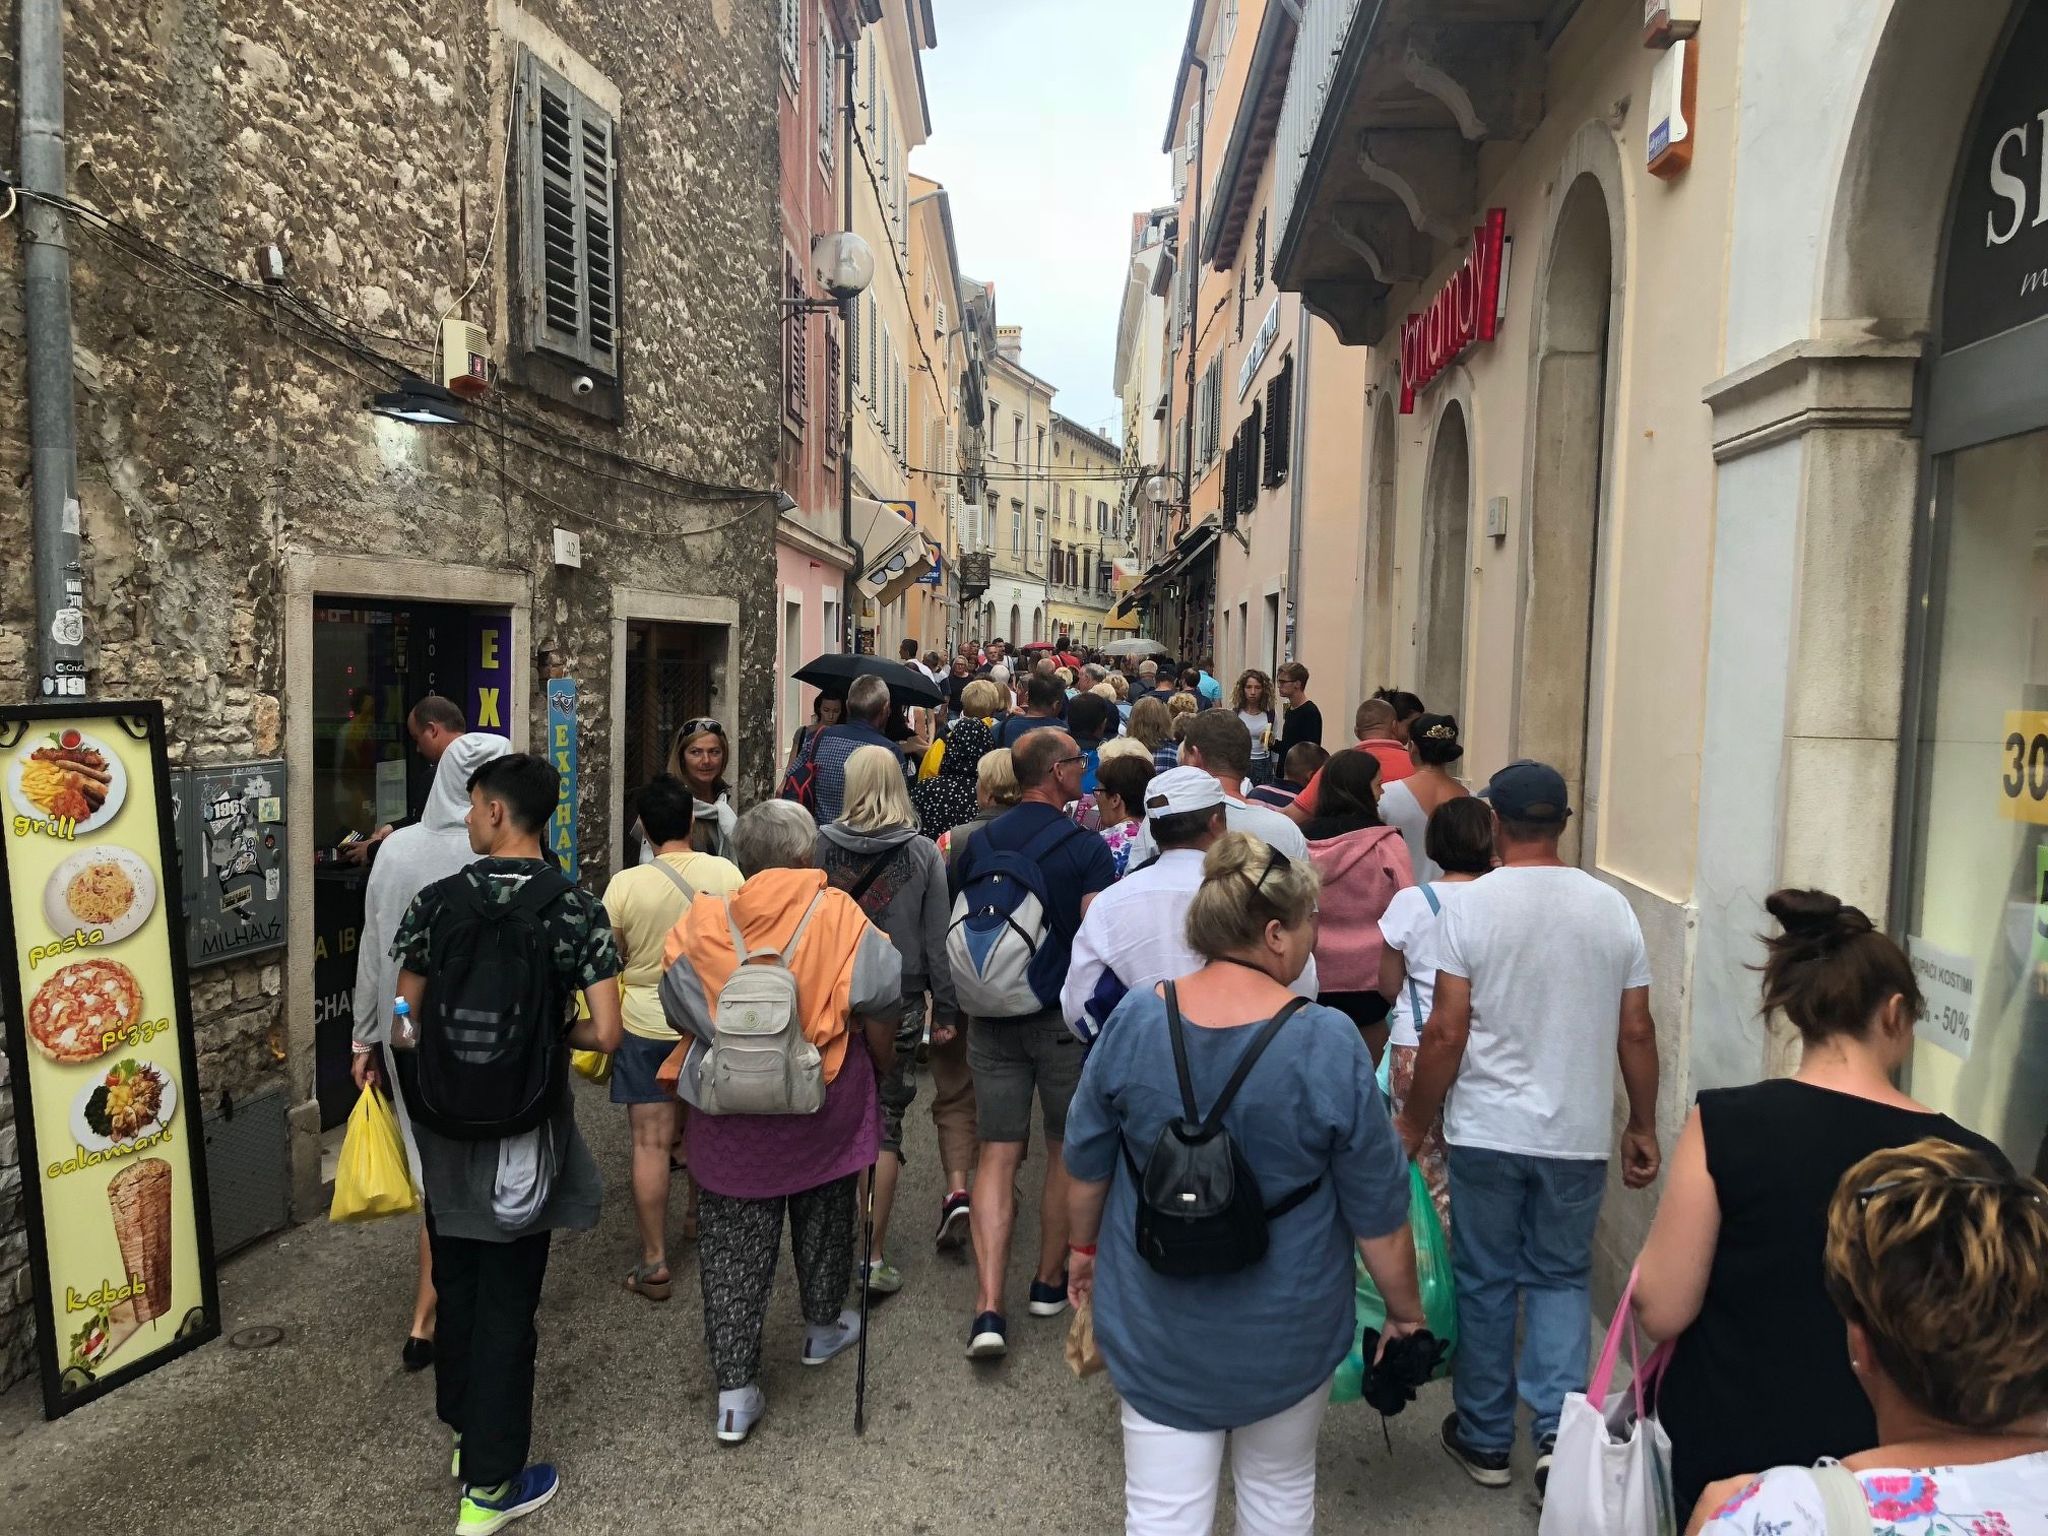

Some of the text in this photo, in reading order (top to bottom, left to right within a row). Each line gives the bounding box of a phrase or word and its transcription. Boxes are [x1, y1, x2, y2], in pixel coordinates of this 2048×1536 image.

[566, 541, 576, 558] 42
[428, 627, 436, 657] NO
[478, 629, 501, 728] EX
[2002, 731, 2048, 802] 30
[554, 724, 573, 874] EXCHAN
[13, 814, 76, 841] grill
[28, 927, 104, 970] pasta
[313, 986, 356, 1025] CHA
[1942, 1004, 1971, 1042] 50%
[102, 1017, 170, 1053] pizza
[47, 1120, 173, 1178] calamari
[66, 1272, 146, 1314] kebab
